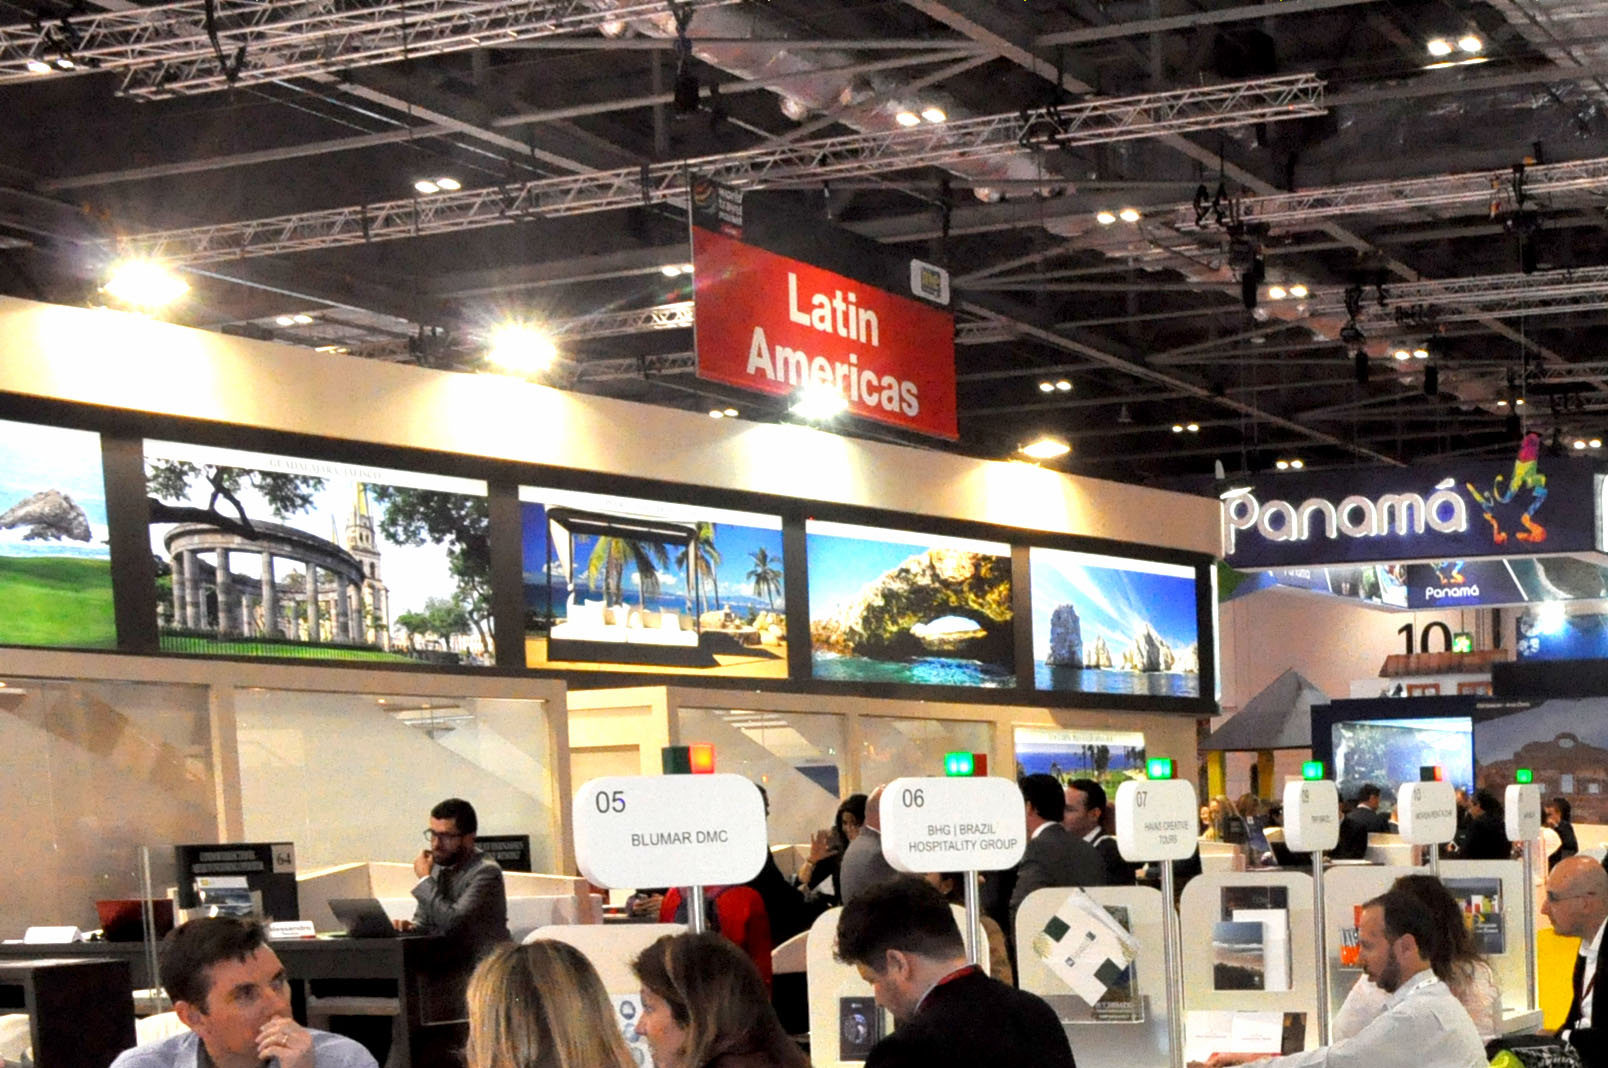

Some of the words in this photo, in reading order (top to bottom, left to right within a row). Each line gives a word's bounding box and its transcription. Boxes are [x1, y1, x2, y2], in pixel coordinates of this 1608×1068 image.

[788, 271, 879, 347] Latin
[746, 325, 919, 417] Americas
[1221, 478, 1467, 556] Panamá
[1425, 583, 1480, 601] Panamá
[1397, 620, 1452, 655] 10
[595, 790, 627, 814] 05
[902, 788, 925, 808] 06
[1136, 790, 1148, 808] 07
[631, 831, 692, 847] BLUMAR
[696, 829, 729, 844] DMC
[927, 824, 951, 836] BHG
[959, 823, 997, 836] BRAZIL
[908, 840, 977, 853] HOSPITALITY
[979, 838, 1018, 851] GROUP
[277, 852, 292, 866] 64
